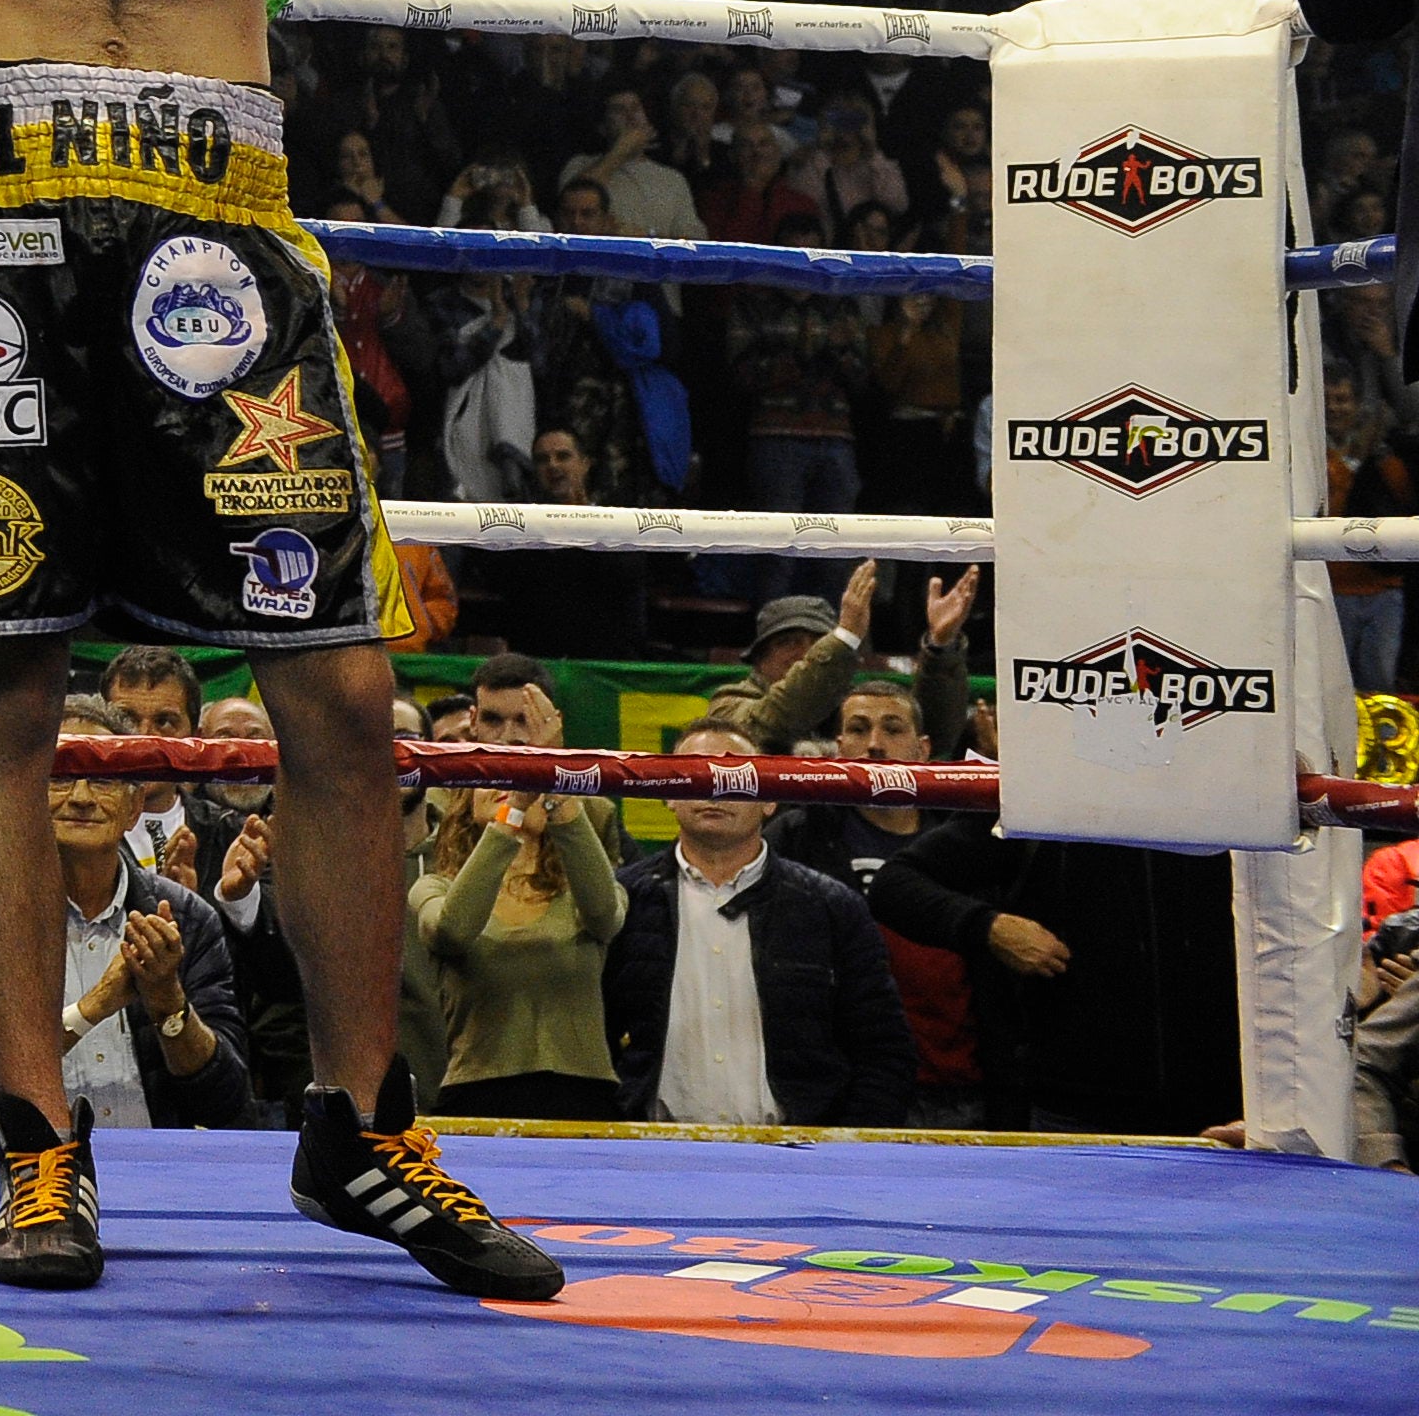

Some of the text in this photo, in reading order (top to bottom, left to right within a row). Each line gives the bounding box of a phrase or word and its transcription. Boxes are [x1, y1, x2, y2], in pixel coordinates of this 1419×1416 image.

[404, 4, 453, 30] CHARLIE
[572, 4, 618, 37] CHARLIE
[640, 18, 708, 27] www.charlie.es
[728, 6, 774, 40] CHARLIE
[795, 21, 862, 29] www.charlie.es
[884, 14, 931, 45] CHARLIE
[51, 85, 231, 183] NIÑO
[1013, 164, 1257, 200] RUDE BOYS
[146, 239, 255, 289] CHAMPION
[177, 317, 219, 333] EBU
[144, 346, 189, 390] EUROPEAN
[1013, 423, 1263, 459] RUDE BOYS
[211, 477, 349, 493] MARAVILLABOX
[222, 493, 342, 509] PROMOTIONS
[476, 506, 526, 533] CHARLIE
[247, 595, 309, 614] WRAP
[1020, 666, 1268, 709] RUDE BOYS
[555, 764, 601, 795] CHARLIE
[710, 762, 759, 798] CHARLIE
